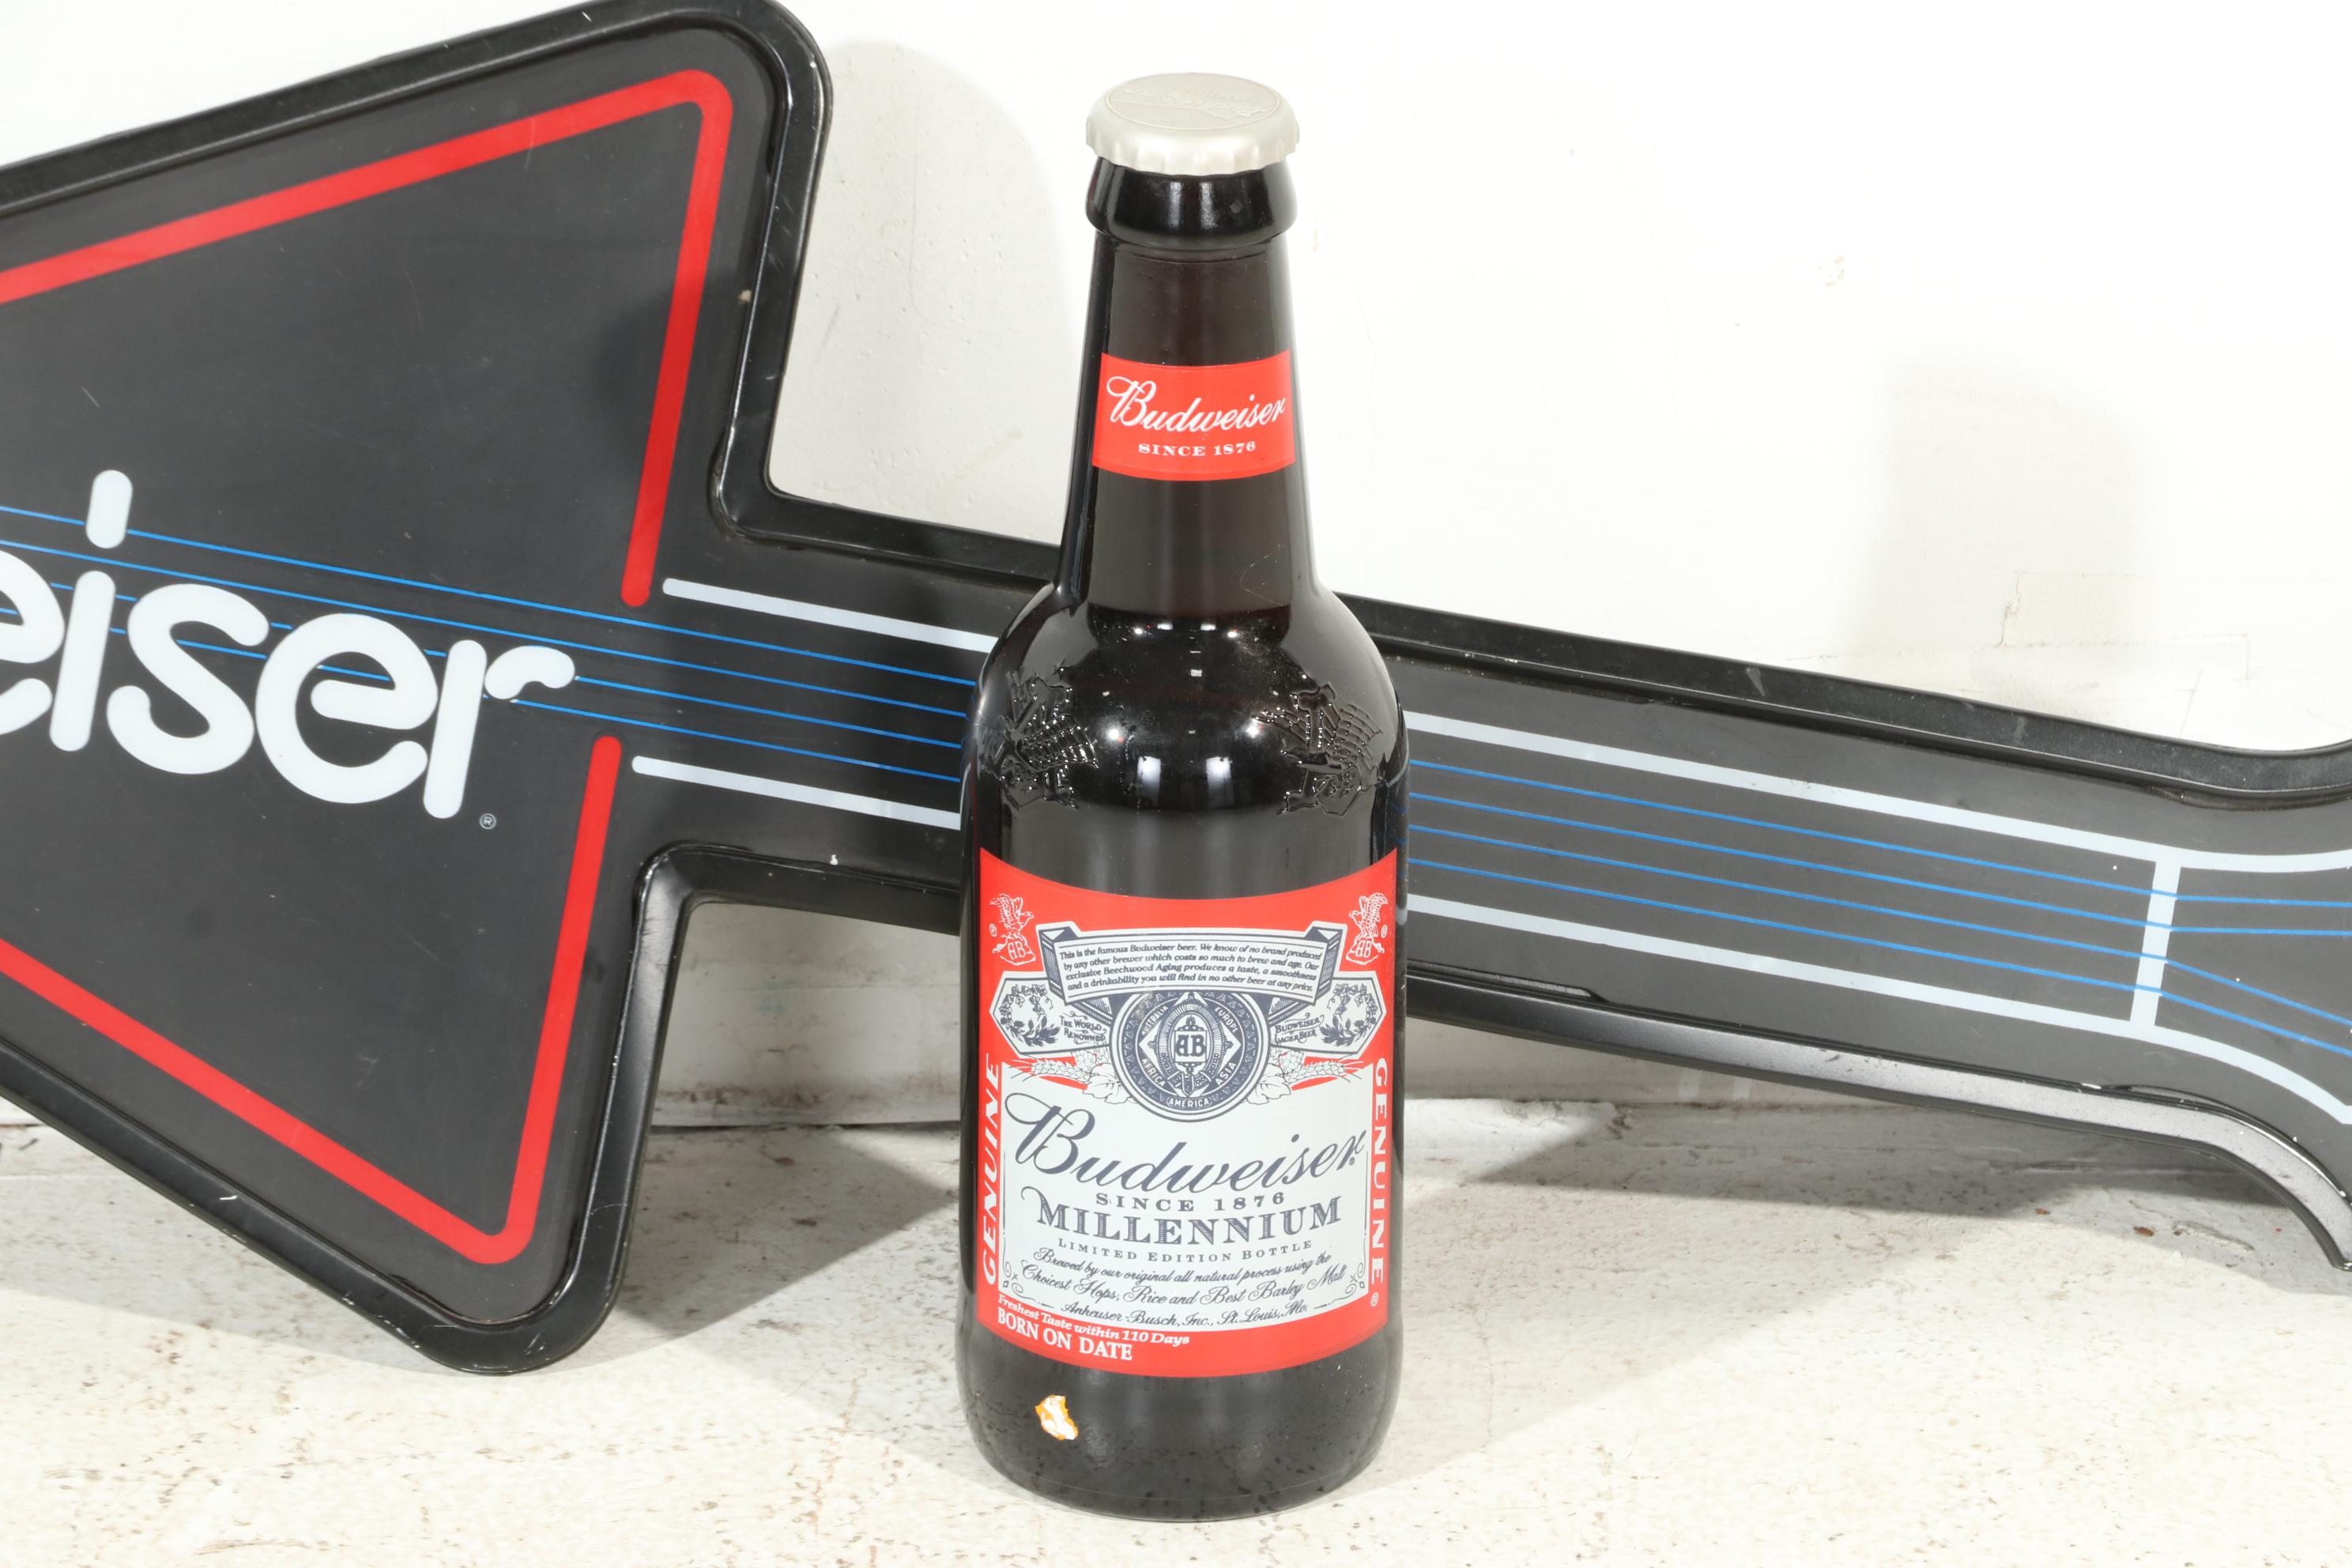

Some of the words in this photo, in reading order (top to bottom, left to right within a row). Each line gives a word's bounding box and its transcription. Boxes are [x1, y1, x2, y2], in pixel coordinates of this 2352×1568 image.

[1106, 376, 1286, 432] Budweiser
[1138, 443, 1206, 457] SINCE
[1214, 441, 1256, 455] 1876
[1059, 952, 1076, 960] This
[1261, 948, 1287, 956] brand
[1287, 949, 1322, 960] produced
[1064, 963, 1072, 971] by
[1074, 962, 1088, 971] any
[1113, 955, 1143, 963] brewer
[1247, 956, 1269, 964] brew
[1270, 958, 1287, 967] and
[1287, 961, 1302, 970] age.
[1305, 961, 1319, 971] Our
[1066, 971, 1102, 980] exclusive
[1103, 965, 1153, 975] Beechwood
[1155, 963, 1182, 972] Aging
[1184, 963, 1226, 972] produces
[1237, 966, 1260, 974] taste,
[1270, 969, 1317, 981] smoothness
[1068, 982, 1082, 990] and
[1090, 974, 1139, 986] drinkability
[1246, 976, 1265, 985] beer
[1292, 982, 1314, 992] price.
[1141, 1006, 1168, 1035] AUSTRALIA
[1214, 1006, 1239, 1033] EUROPE
[1141, 1058, 1166, 1087] AFRICA
[1215, 1062, 1237, 1086] ASIA
[1168, 1099, 1210, 1108] AMERICA
[1004, 1092, 1367, 1193] Budweiser
[983, 1053, 999, 1285] GENUINE
[1371, 1057, 1388, 1284] GENUINE
[1021, 1185, 1342, 1246] MILLENNIUM
[1095, 1193, 1194, 1212] SINCE
[1214, 1192, 1284, 1212] 1876
[1058, 1238, 1137, 1260] LIMITED
[1148, 1252, 1231, 1263] EDITION
[1242, 1240, 1312, 1260] BOTTLE
[1033, 1247, 1084, 1272] Brewed
[1084, 1261, 1099, 1279] by
[1101, 1268, 1123, 1278] our
[1125, 1268, 1173, 1286] original
[1174, 1269, 1195, 1283] all
[1193, 1267, 1242, 1283] natural
[1236, 1265, 1283, 1286] process
[1284, 1258, 1315, 1275] using
[1315, 1250, 1332, 1265] the
[1020, 1259, 1072, 1291] Choicest
[1073, 1277, 1120, 1304] Hops,
[1122, 1285, 1167, 1304] Rice
[1170, 1291, 1200, 1305] and
[1200, 1285, 1248, 1305] Best
[1248, 1280, 1305, 1301] Barley
[1306, 1264, 1348, 1290] Malt
[998, 1294, 1040, 1320] Freshest
[1041, 1312, 1072, 1331] Taste
[1074, 1324, 1120, 1340] within
[1122, 1330, 1148, 1342] 110
[1150, 1332, 1190, 1348] Days
[1217, 1310, 1239, 1325] St.
[1238, 1307, 1281, 1324] Louis,
[1281, 1298, 1308, 1317] Mo.
[997, 1306, 1039, 1341] BORN
[1042, 1328, 1072, 1351] ON
[1079, 1336, 1133, 1361] DATE
